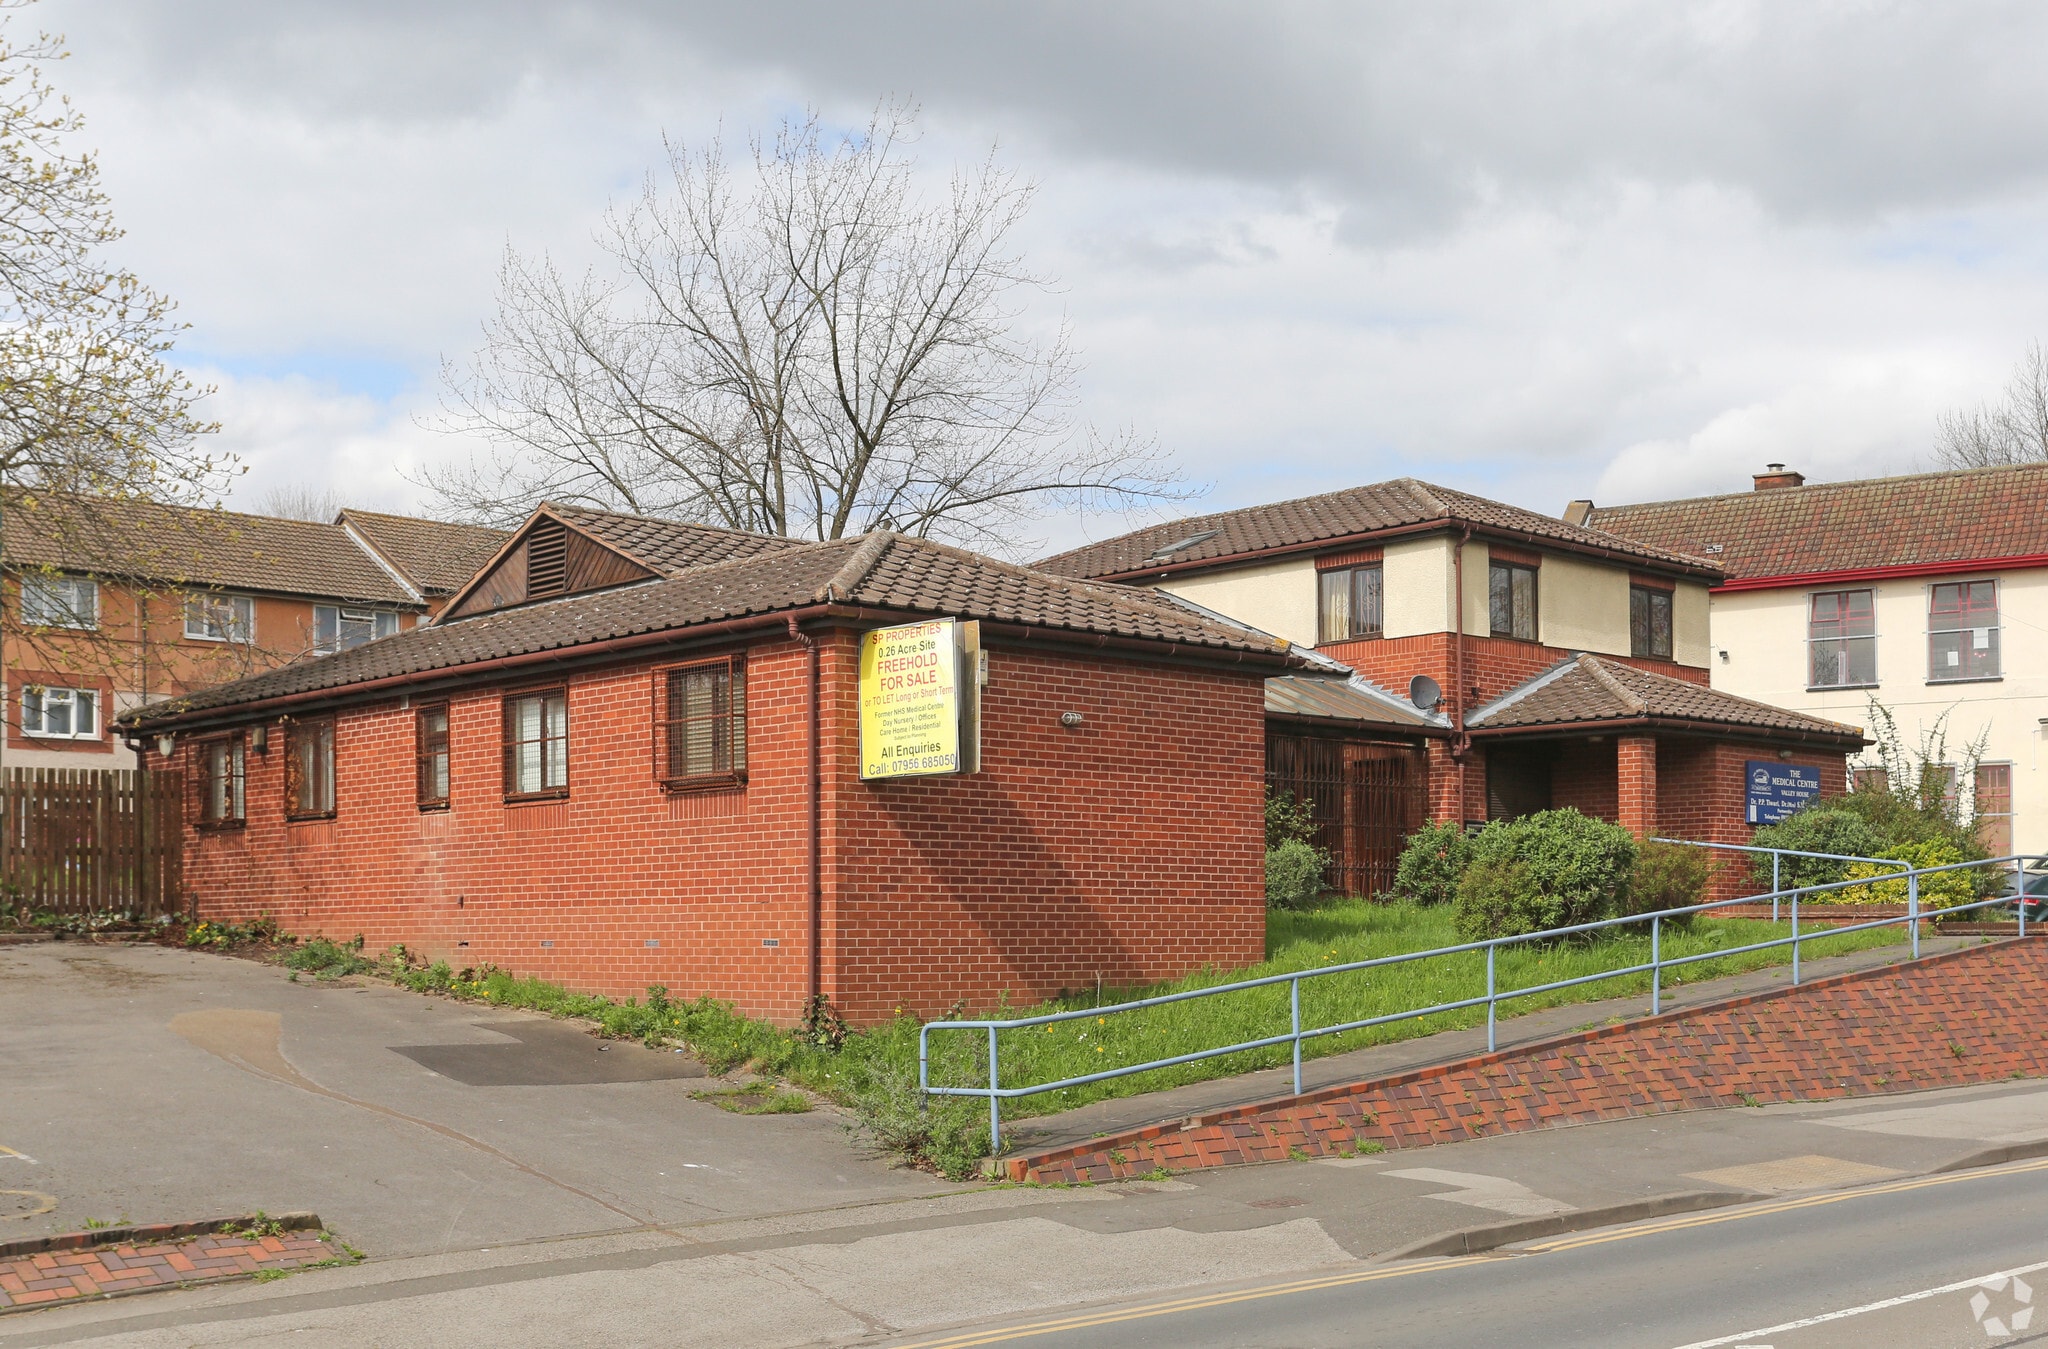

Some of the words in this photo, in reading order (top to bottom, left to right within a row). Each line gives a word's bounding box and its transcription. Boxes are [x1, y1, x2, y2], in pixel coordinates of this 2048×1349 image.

[873, 634, 883, 644] SP
[886, 623, 941, 642] PROPERTIES
[879, 646, 895, 658] 0.26
[898, 644, 917, 654] Acre
[920, 640, 935, 651] Site
[878, 653, 937, 674] FREEHOLD
[881, 676, 903, 691] FOR
[907, 670, 936, 687] SALE
[873, 696, 881, 705] TO
[883, 694, 894, 704] LET
[896, 692, 911, 702] Long
[921, 688, 937, 698] Short
[939, 686, 953, 695] Term
[875, 710, 893, 719] Former
[906, 704, 926, 713] Medical
[883, 719, 892, 727] Day
[894, 716, 914, 724] Nursery
[893, 726, 907, 734] Home
[912, 721, 941, 731] Residential
[882, 747, 893, 758] All
[897, 741, 941, 757] Enquiries
[869, 763, 889, 775] Call:
[893, 758, 919, 772] 07956
[922, 754, 954, 768] 685050
[1790, 770, 1801, 778] THE
[1772, 778, 1796, 787] MEDICAL
[1797, 780, 1818, 789] CENTRE
